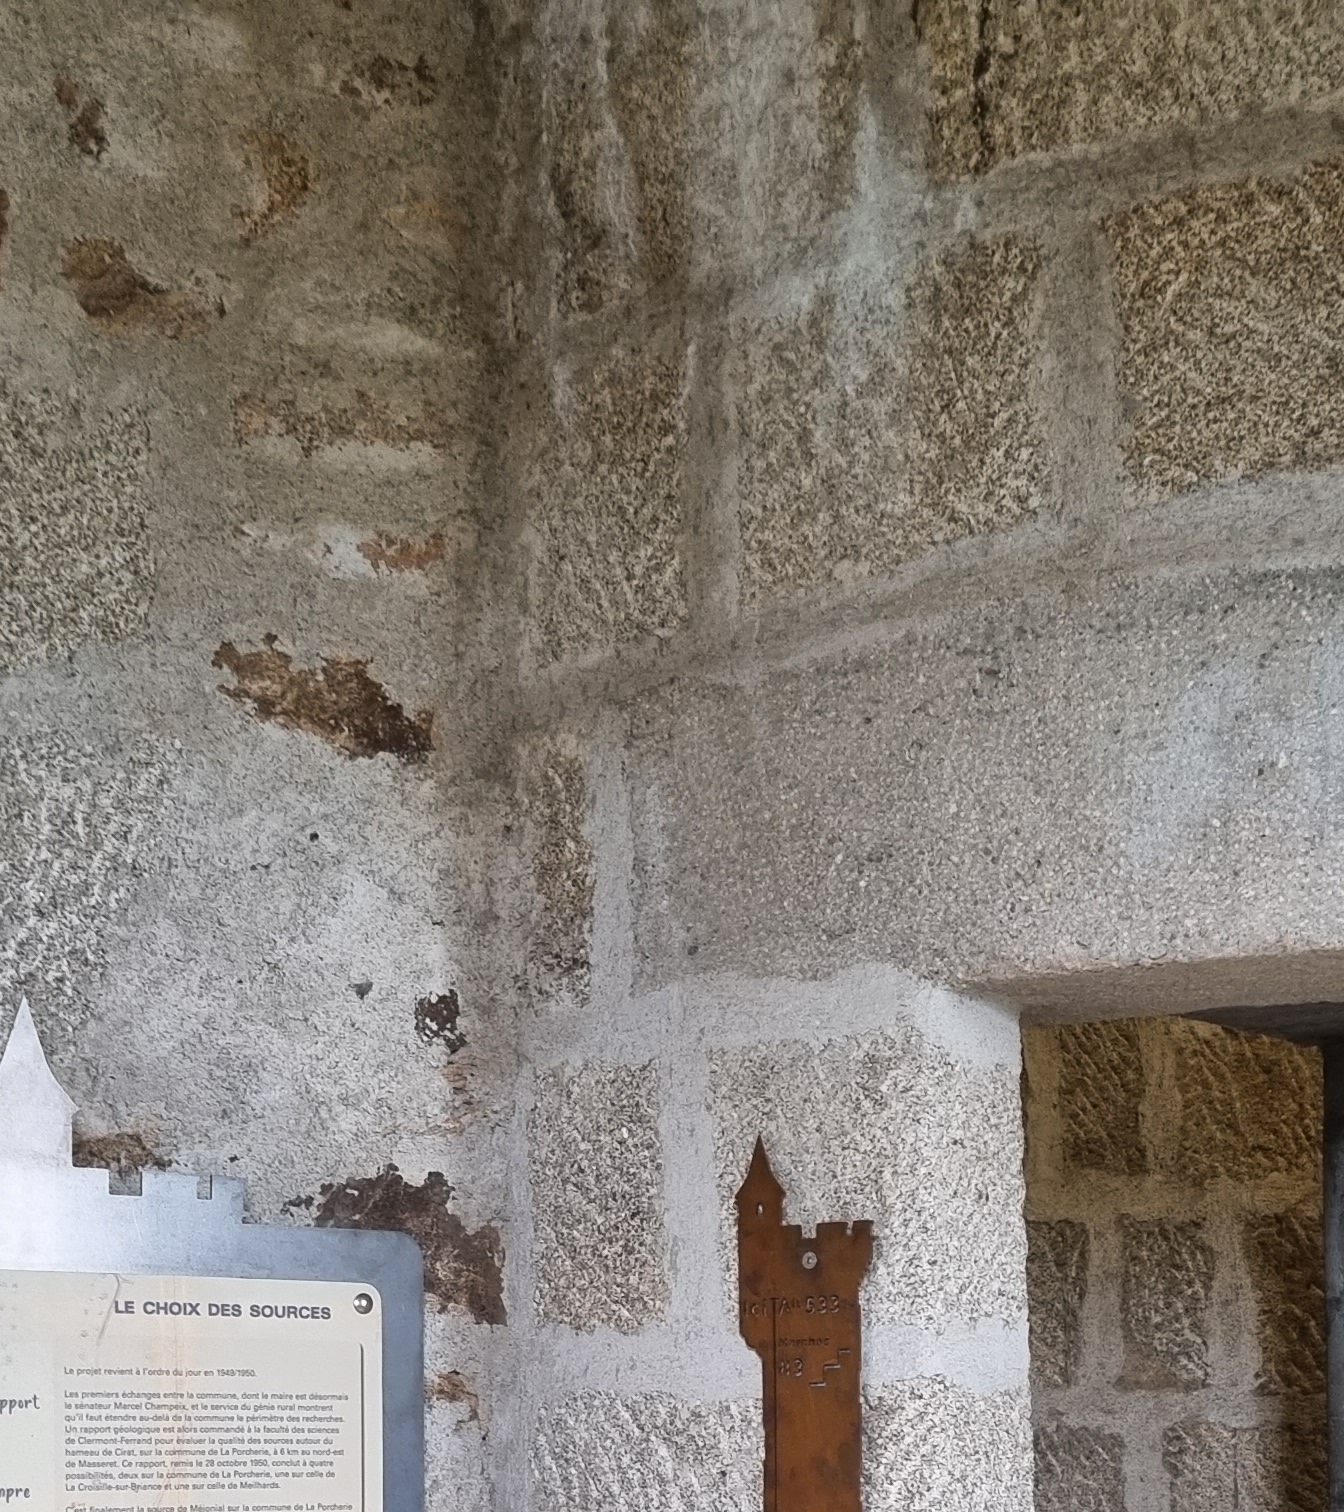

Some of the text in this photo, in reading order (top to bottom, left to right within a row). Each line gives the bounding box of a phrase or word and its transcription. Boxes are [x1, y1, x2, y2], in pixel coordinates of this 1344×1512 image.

[114, 1300, 331, 1319] LE CHOIX DES SOURCES
